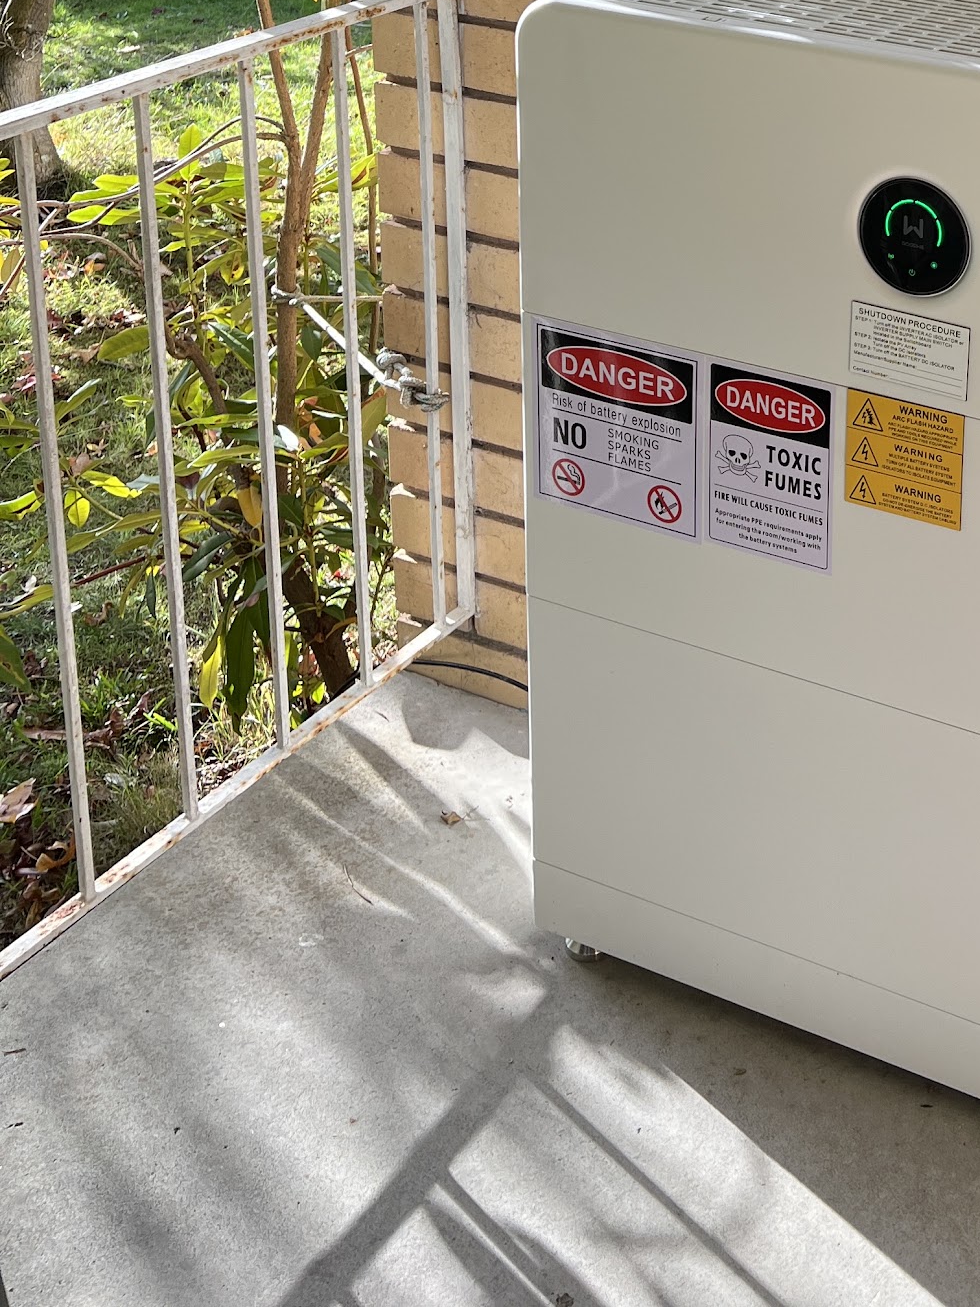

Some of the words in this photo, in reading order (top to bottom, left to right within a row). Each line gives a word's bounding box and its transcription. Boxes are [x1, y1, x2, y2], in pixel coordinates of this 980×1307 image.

[859, 308, 907, 325] SHUTDOWN
[908, 319, 961, 338] PROCEDURE
[561, 352, 675, 401] DANGER
[552, 393, 573, 409] Risk
[577, 401, 587, 413] of
[590, 403, 628, 426] battery
[632, 415, 681, 438] explosion
[726, 385, 816, 428] DANGER
[899, 405, 948, 424] WARNING
[553, 417, 587, 450] NO
[607, 428, 660, 451] SMOKING
[906, 418, 927, 427] FLASH
[928, 423, 954, 434] HAZARD
[607, 441, 651, 460] SPARKS
[608, 453, 652, 473] FLAMES
[766, 445, 822, 476] TOXIC
[894, 444, 943, 463] WARNING
[765, 470, 822, 501] FUMES
[894, 484, 941, 504] WARNING
[714, 490, 730, 502] FIRE
[731, 494, 749, 507] WILL
[750, 500, 773, 513] CAUSE
[775, 506, 797, 519] TOXIC
[799, 512, 823, 526] FUMES
[715, 508, 751, 523] Appropriate
[751, 517, 763, 526] PPE
[764, 521, 804, 537] requirements
[805, 531, 823, 542] apply
[716, 517, 725, 526] for
[725, 520, 751, 533] entering
[752, 526, 762, 535] the
[762, 529, 806, 548] room/working
[807, 539, 821, 551] with
[738, 532, 749, 541] the
[749, 535, 772, 548] battery
[772, 541, 798, 554] systems
